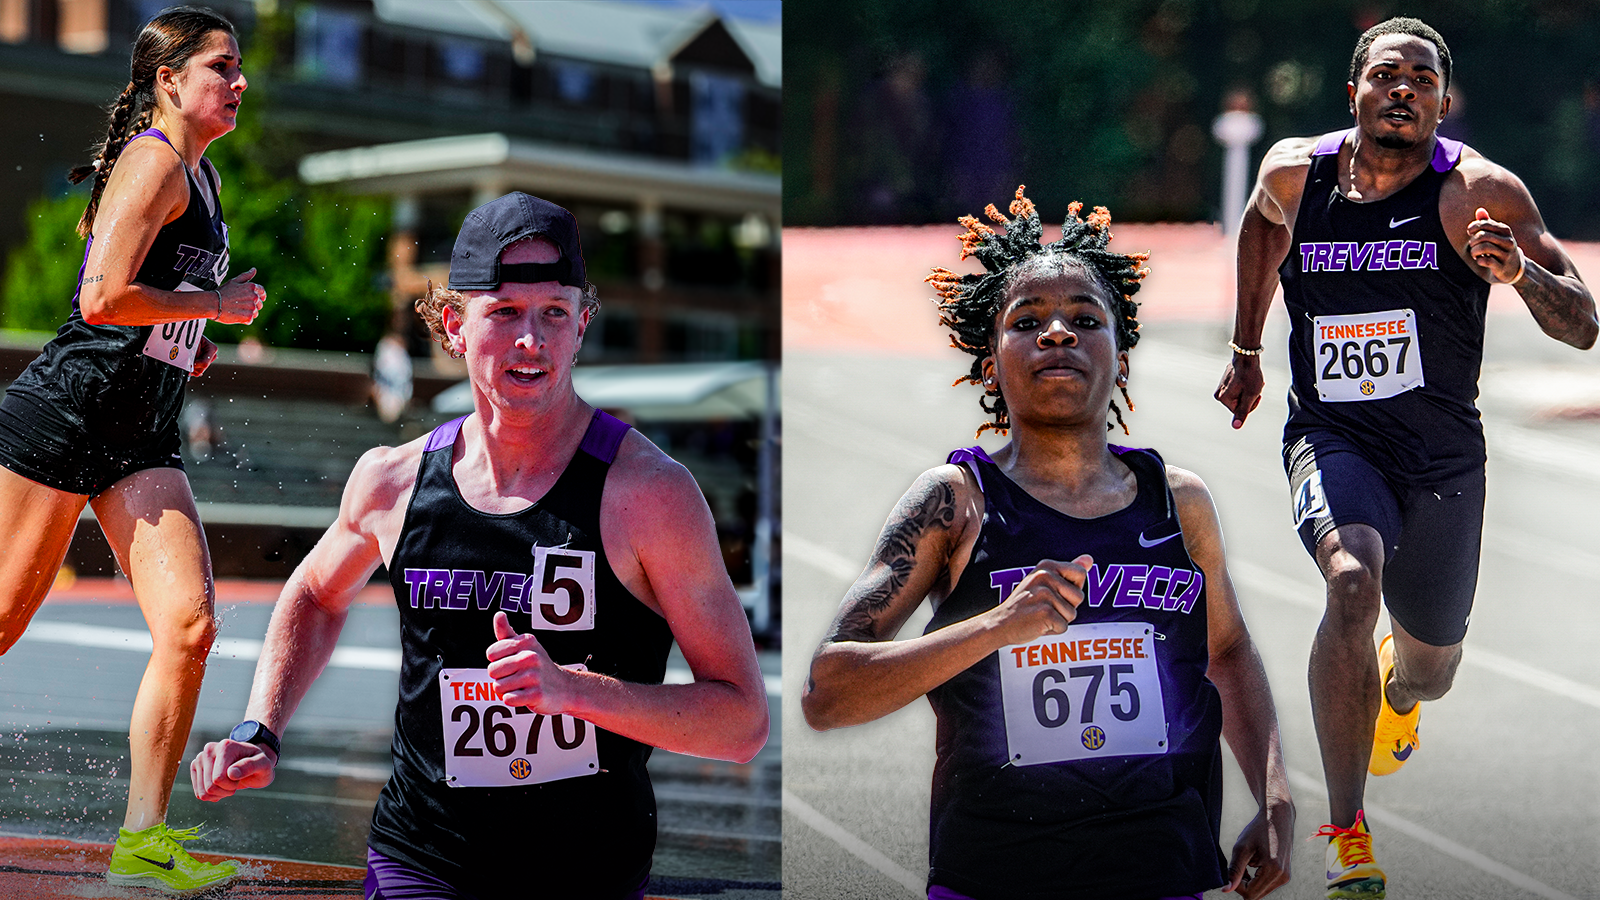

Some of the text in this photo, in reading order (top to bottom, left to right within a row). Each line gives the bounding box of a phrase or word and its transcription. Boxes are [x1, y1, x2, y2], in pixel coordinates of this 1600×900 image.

[1300, 240, 1439, 272] TREVECCA
[1319, 319, 1407, 339] TENNESSEE
[1319, 336, 1411, 380] 2667
[540, 554, 585, 625] 5
[1011, 638, 1146, 668] TENNESSEE
[1032, 664, 1141, 728] 675
[451, 704, 586, 757] 2670
[1082, 726, 1105, 750] SEC
[510, 758, 531, 779] SEC
